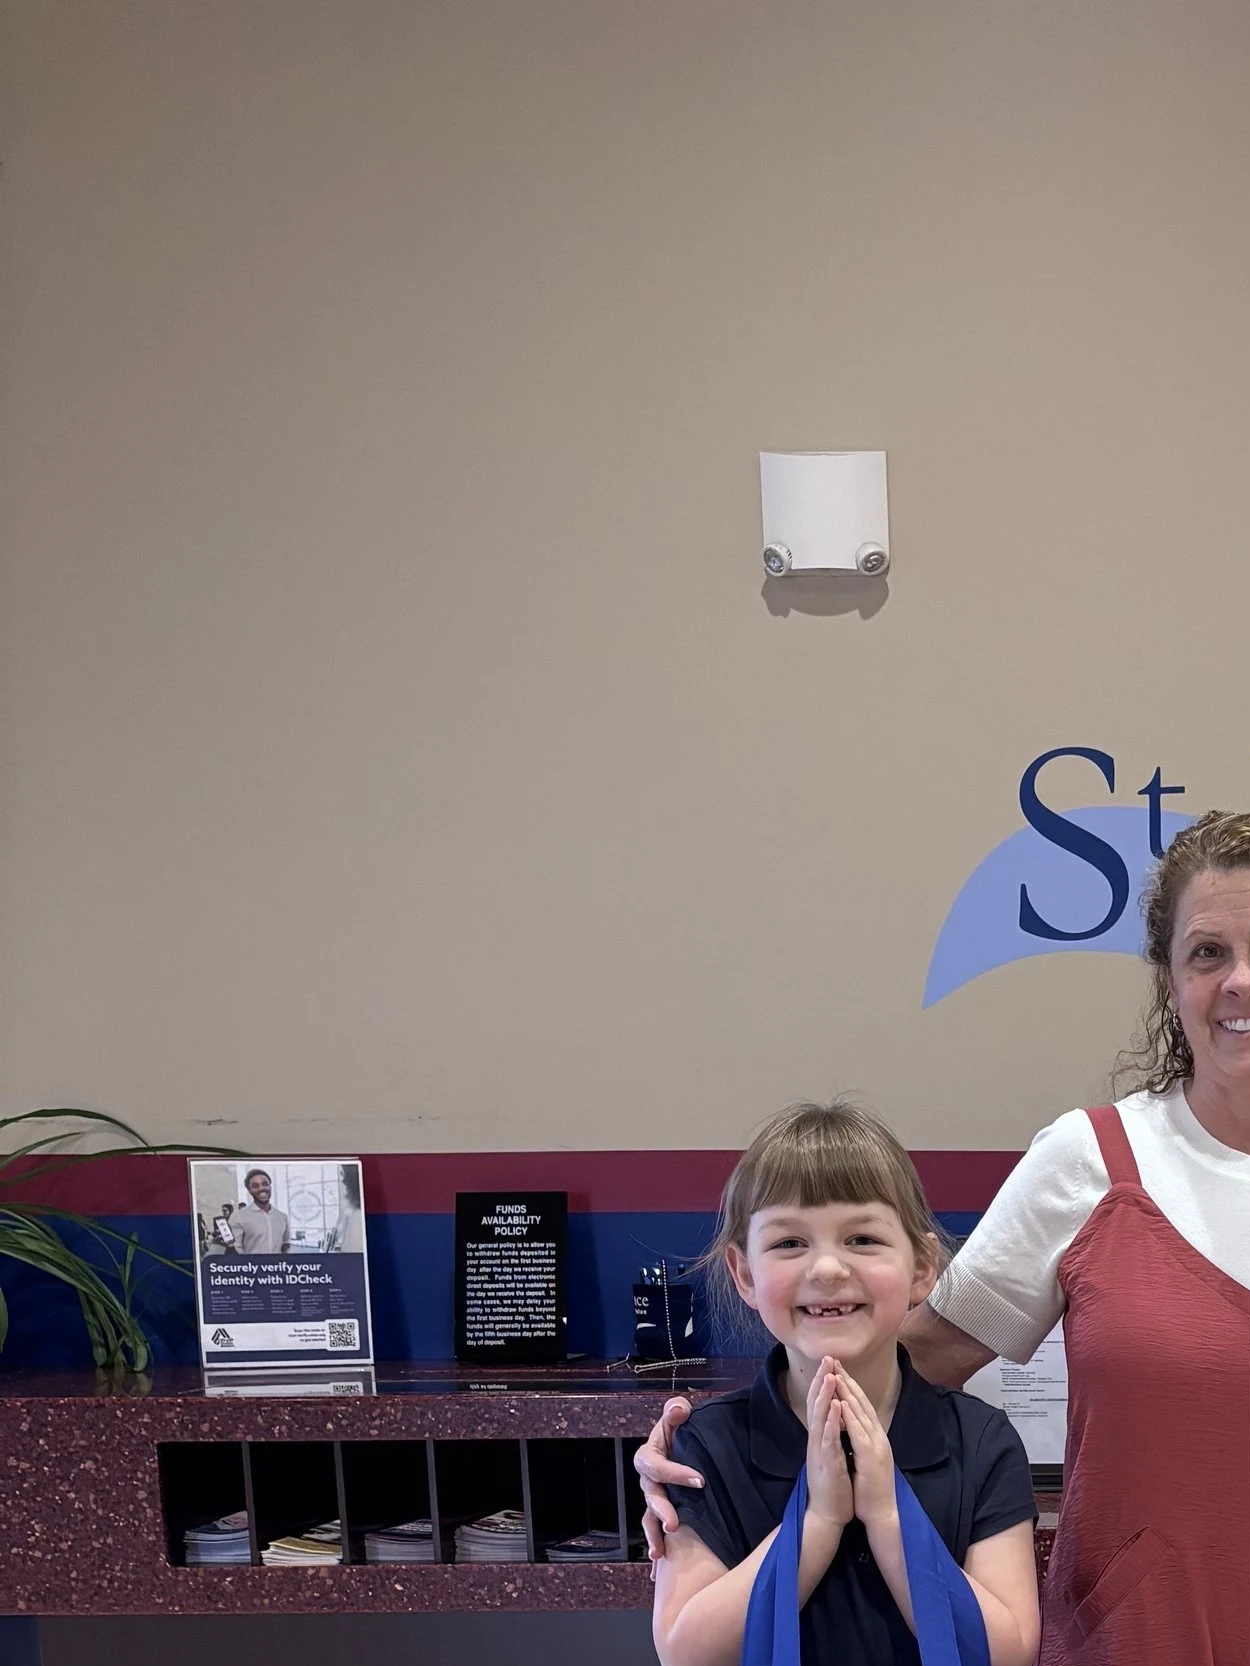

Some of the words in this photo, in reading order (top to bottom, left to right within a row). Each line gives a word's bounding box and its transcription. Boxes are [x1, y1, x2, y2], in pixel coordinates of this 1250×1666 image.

[496, 1205, 527, 1214] FUNDS
[481, 1216, 541, 1225] AVAILABILITY
[495, 1227, 528, 1235] POLICY
[210, 1262, 258, 1273] Securely
[261, 1262, 293, 1273] verify
[296, 1263, 321, 1272] your
[211, 1275, 255, 1286] identity
[258, 1274, 283, 1284] with
[286, 1274, 332, 1284] IDCheck
